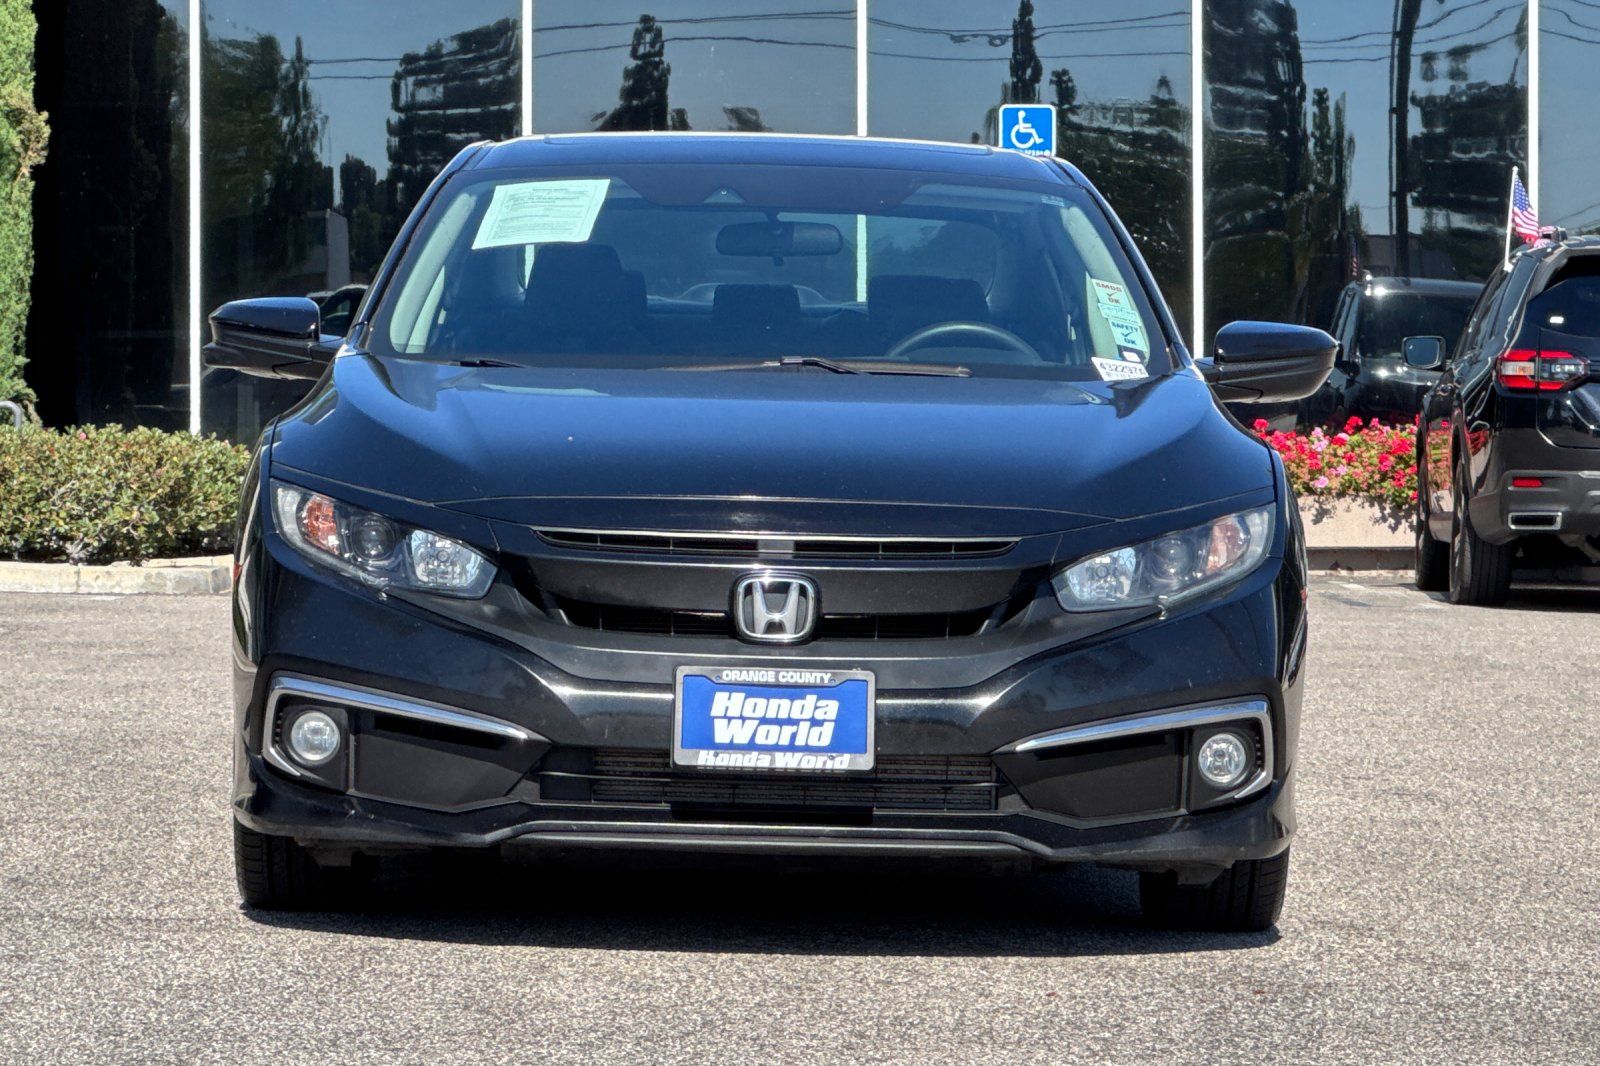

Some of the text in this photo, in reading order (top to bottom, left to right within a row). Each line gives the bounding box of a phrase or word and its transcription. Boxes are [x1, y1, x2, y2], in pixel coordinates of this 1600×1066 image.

[722, 670, 832, 684] ORANGE COUNTY
[710, 691, 840, 720] Honda
[713, 718, 835, 747] World
[696, 750, 850, 769] Honda World
